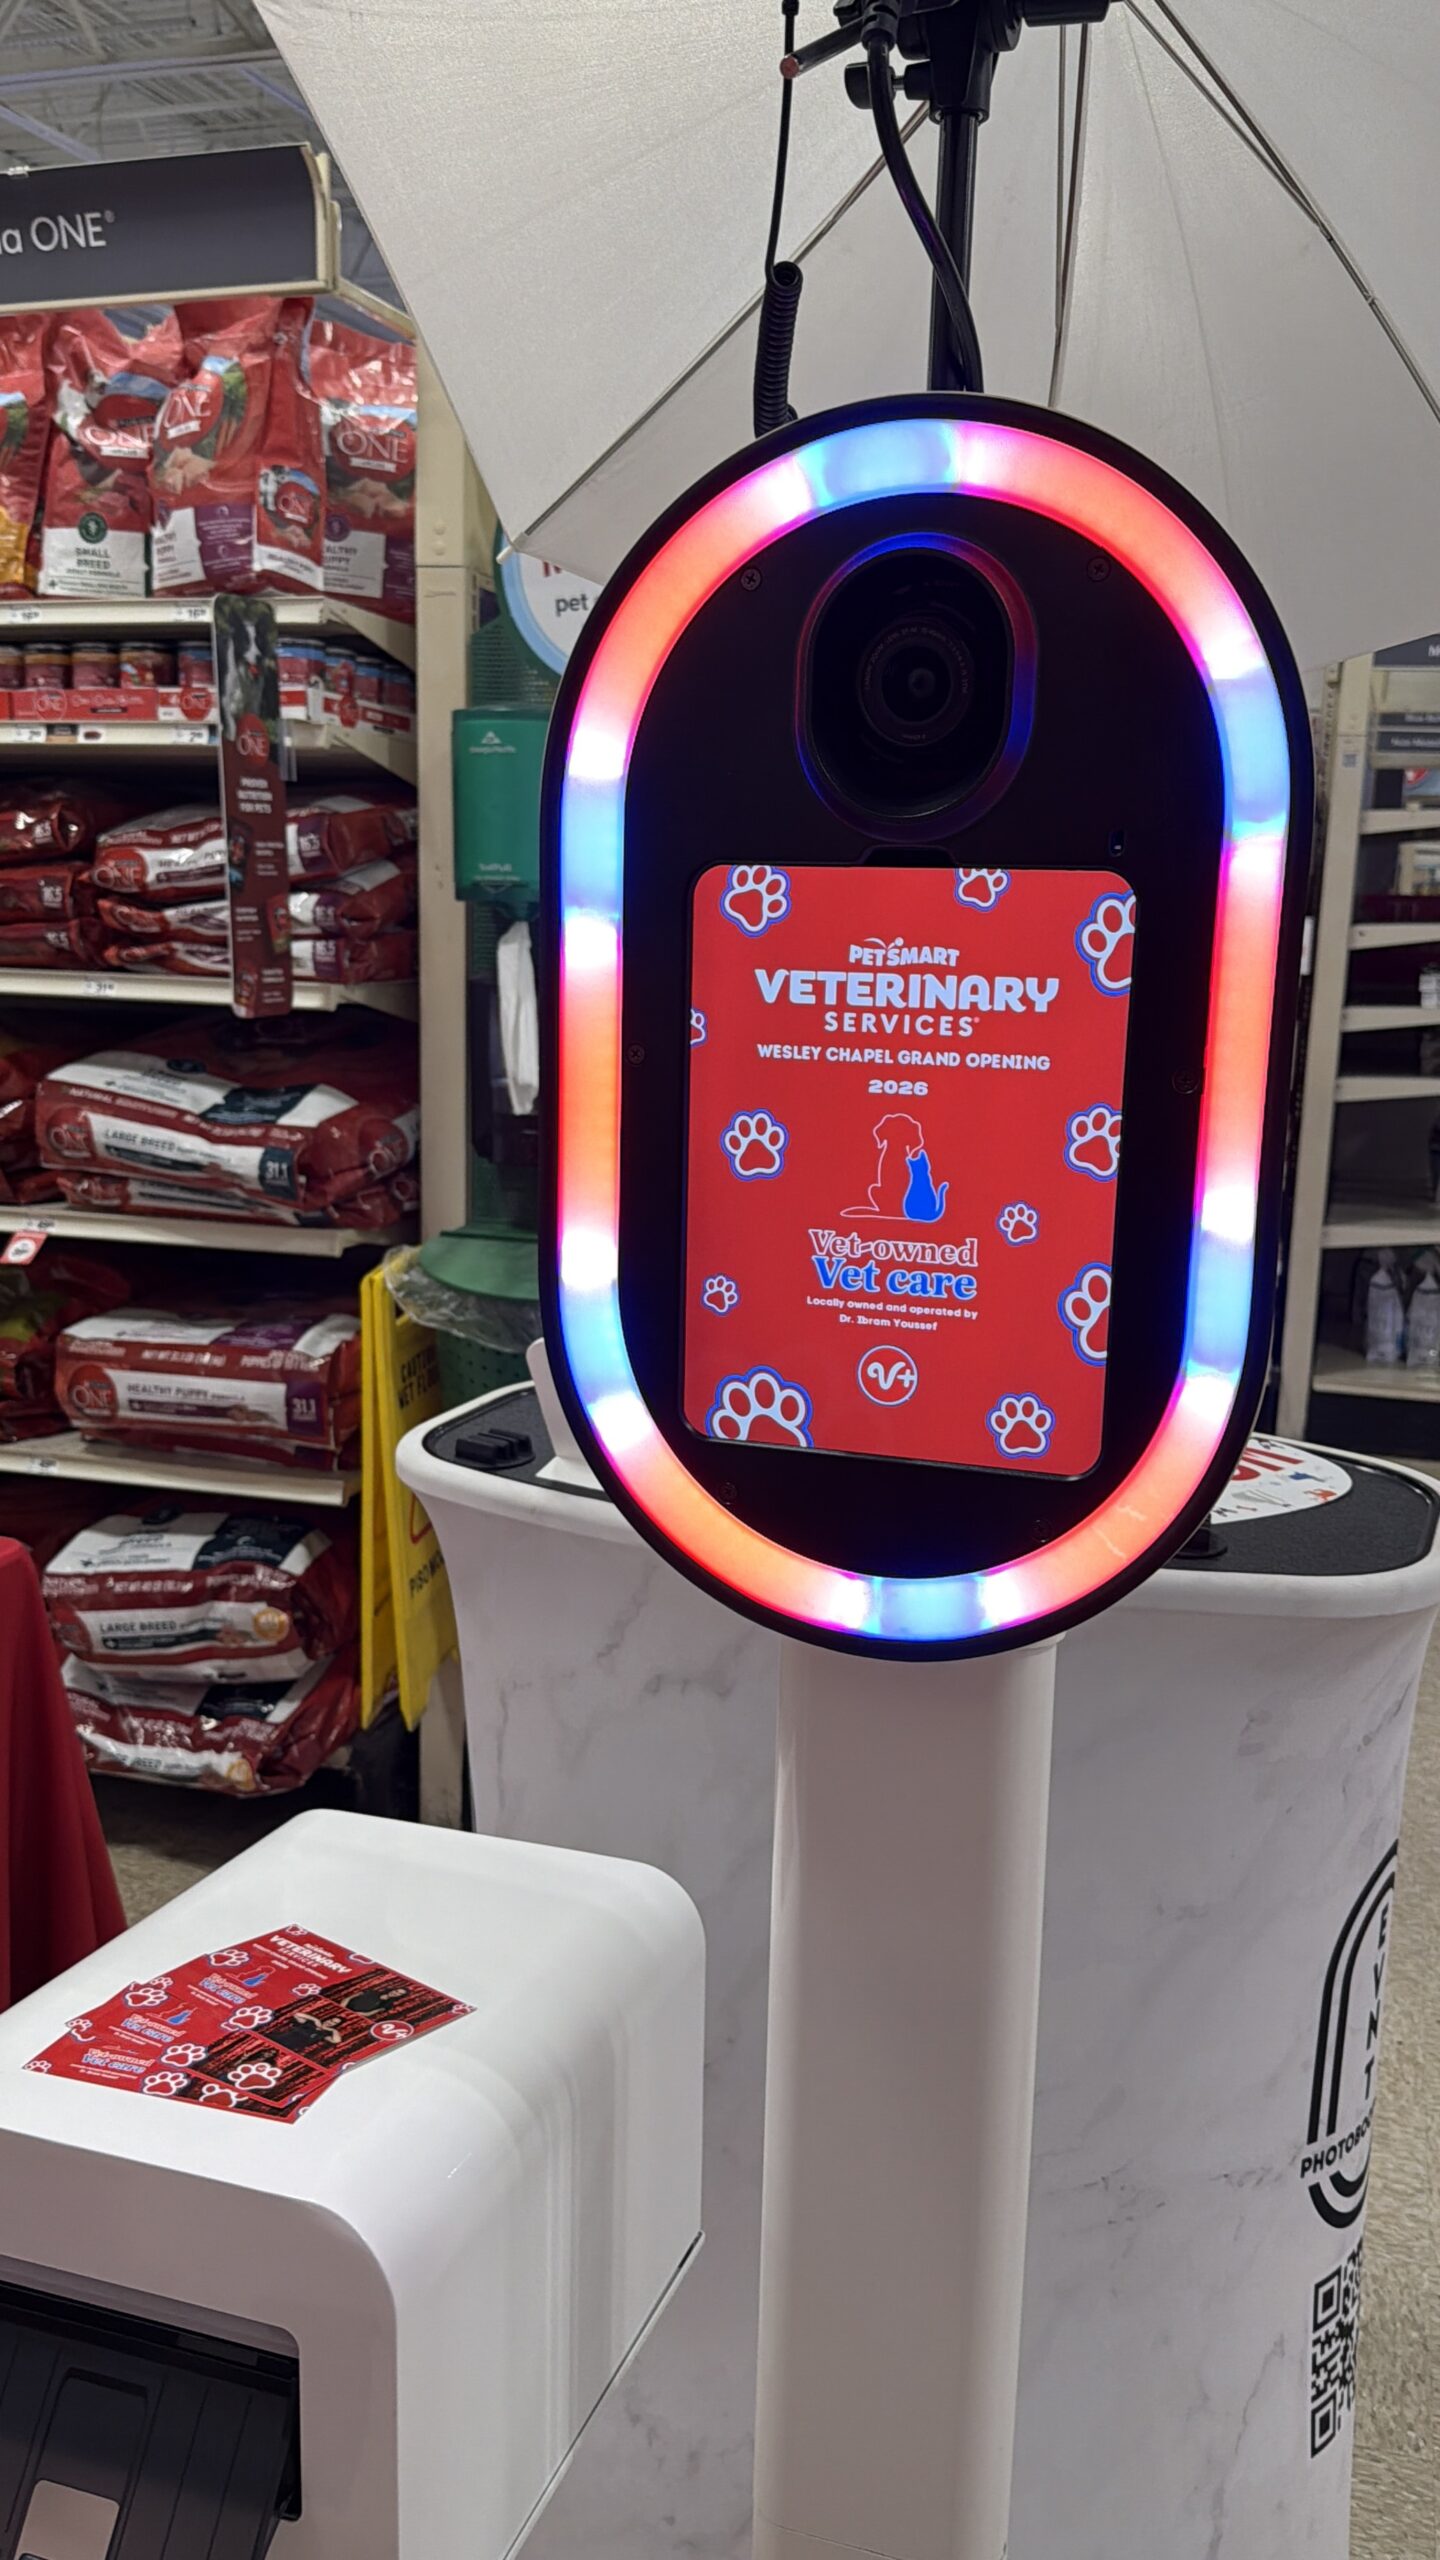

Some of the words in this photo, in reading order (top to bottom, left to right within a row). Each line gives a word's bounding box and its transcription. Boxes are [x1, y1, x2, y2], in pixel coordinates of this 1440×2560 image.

[0, 229, 23, 254] a
[336, 427, 411, 463] ONE
[555, 593, 589, 618] pet
[754, 968, 1059, 1013] VETERINARY
[757, 1043, 822, 1061] WESLEY
[825, 1046, 894, 1065] CHAPEL
[897, 1049, 961, 1067] GRAND
[965, 1052, 1051, 1071] OPENING
[868, 1079, 929, 1096] 2026
[105, 1129, 138, 1143] LARGE
[140, 1136, 176, 1151] BREED
[808, 1228, 979, 1267] Vet-owned
[811, 1255, 881, 1293] Vet
[886, 1268, 977, 1300] care
[806, 1296, 845, 1309] Locally
[847, 1300, 884, 1311] owned
[885, 1303, 908, 1313] and
[909, 1304, 962, 1318] operated
[963, 1308, 978, 1320] by
[839, 1313, 855, 1324] Dr.
[857, 1314, 891, 1327] Ibram
[893, 1318, 938, 1331] Youssef
[126, 1382, 172, 1396] HEALTHY
[174, 1387, 209, 1401] PUPPY
[100, 1620, 135, 1633] LARGE
[139, 1619, 177, 1633] BREED
[269, 1934, 353, 1974] VETERINARY
